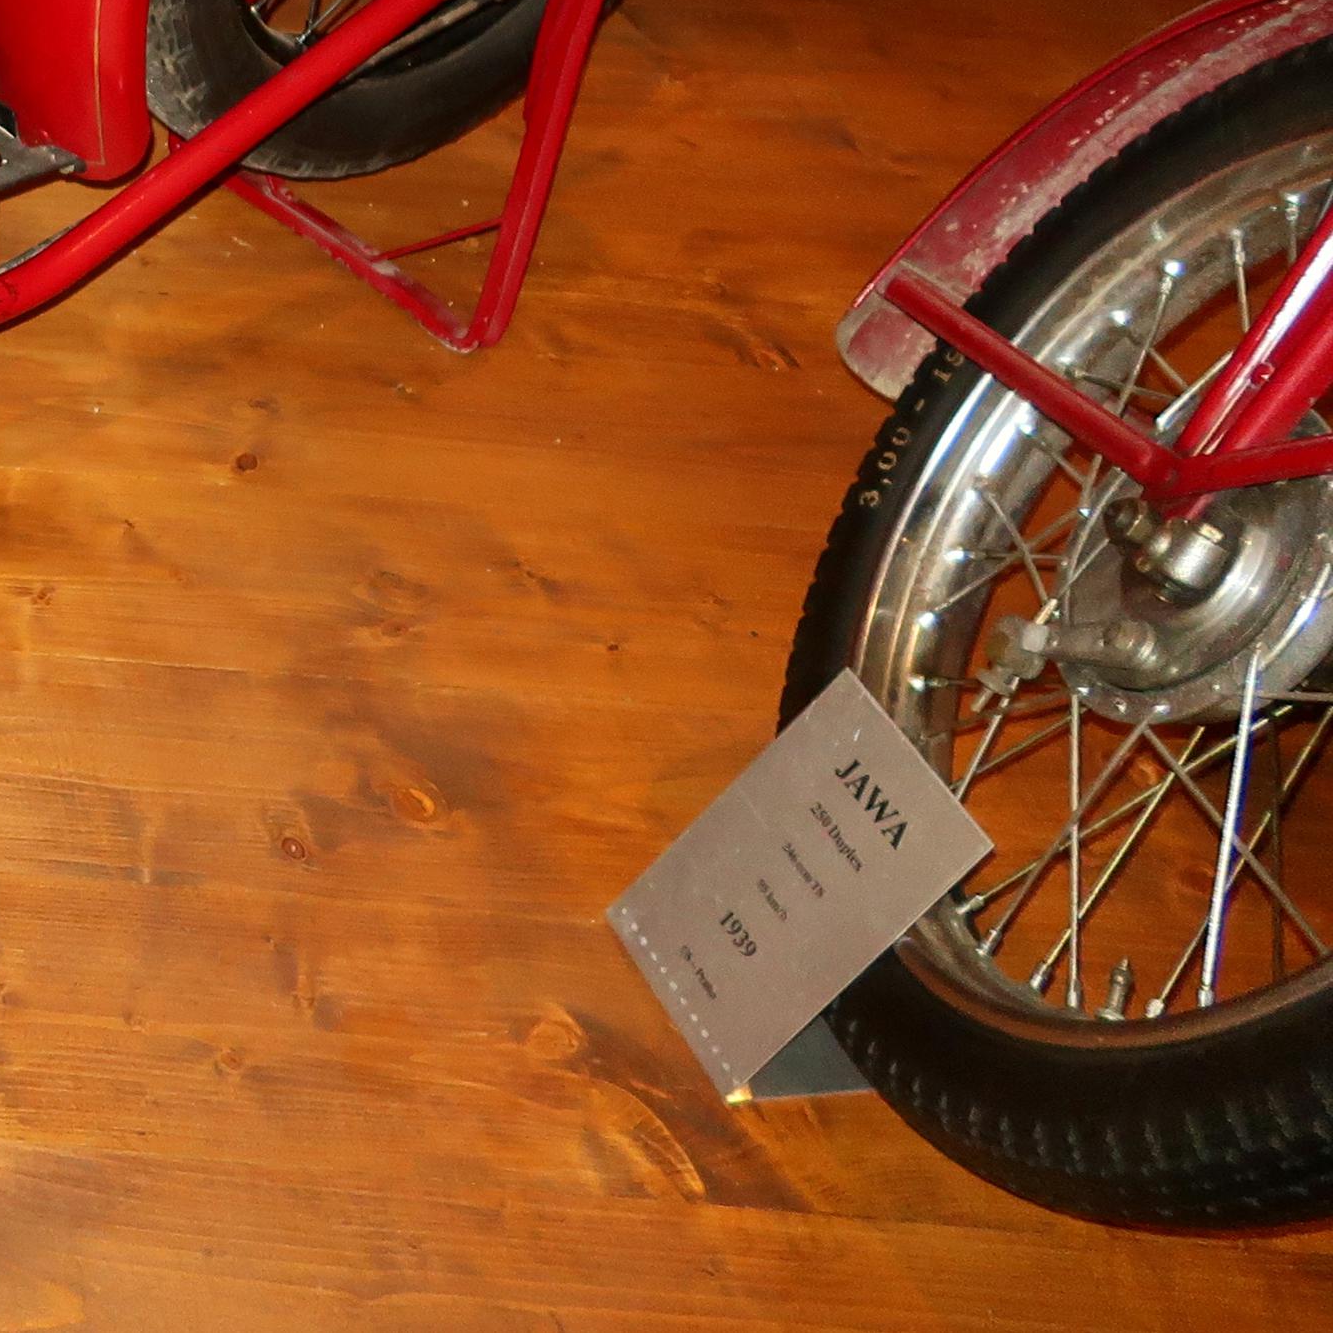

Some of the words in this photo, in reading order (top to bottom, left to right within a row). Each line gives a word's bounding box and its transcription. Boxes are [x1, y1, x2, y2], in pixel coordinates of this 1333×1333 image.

[835, 759, 909, 851] JAWA
[828, 824, 864, 872] Duplex
[719, 910, 758, 957] 1939
